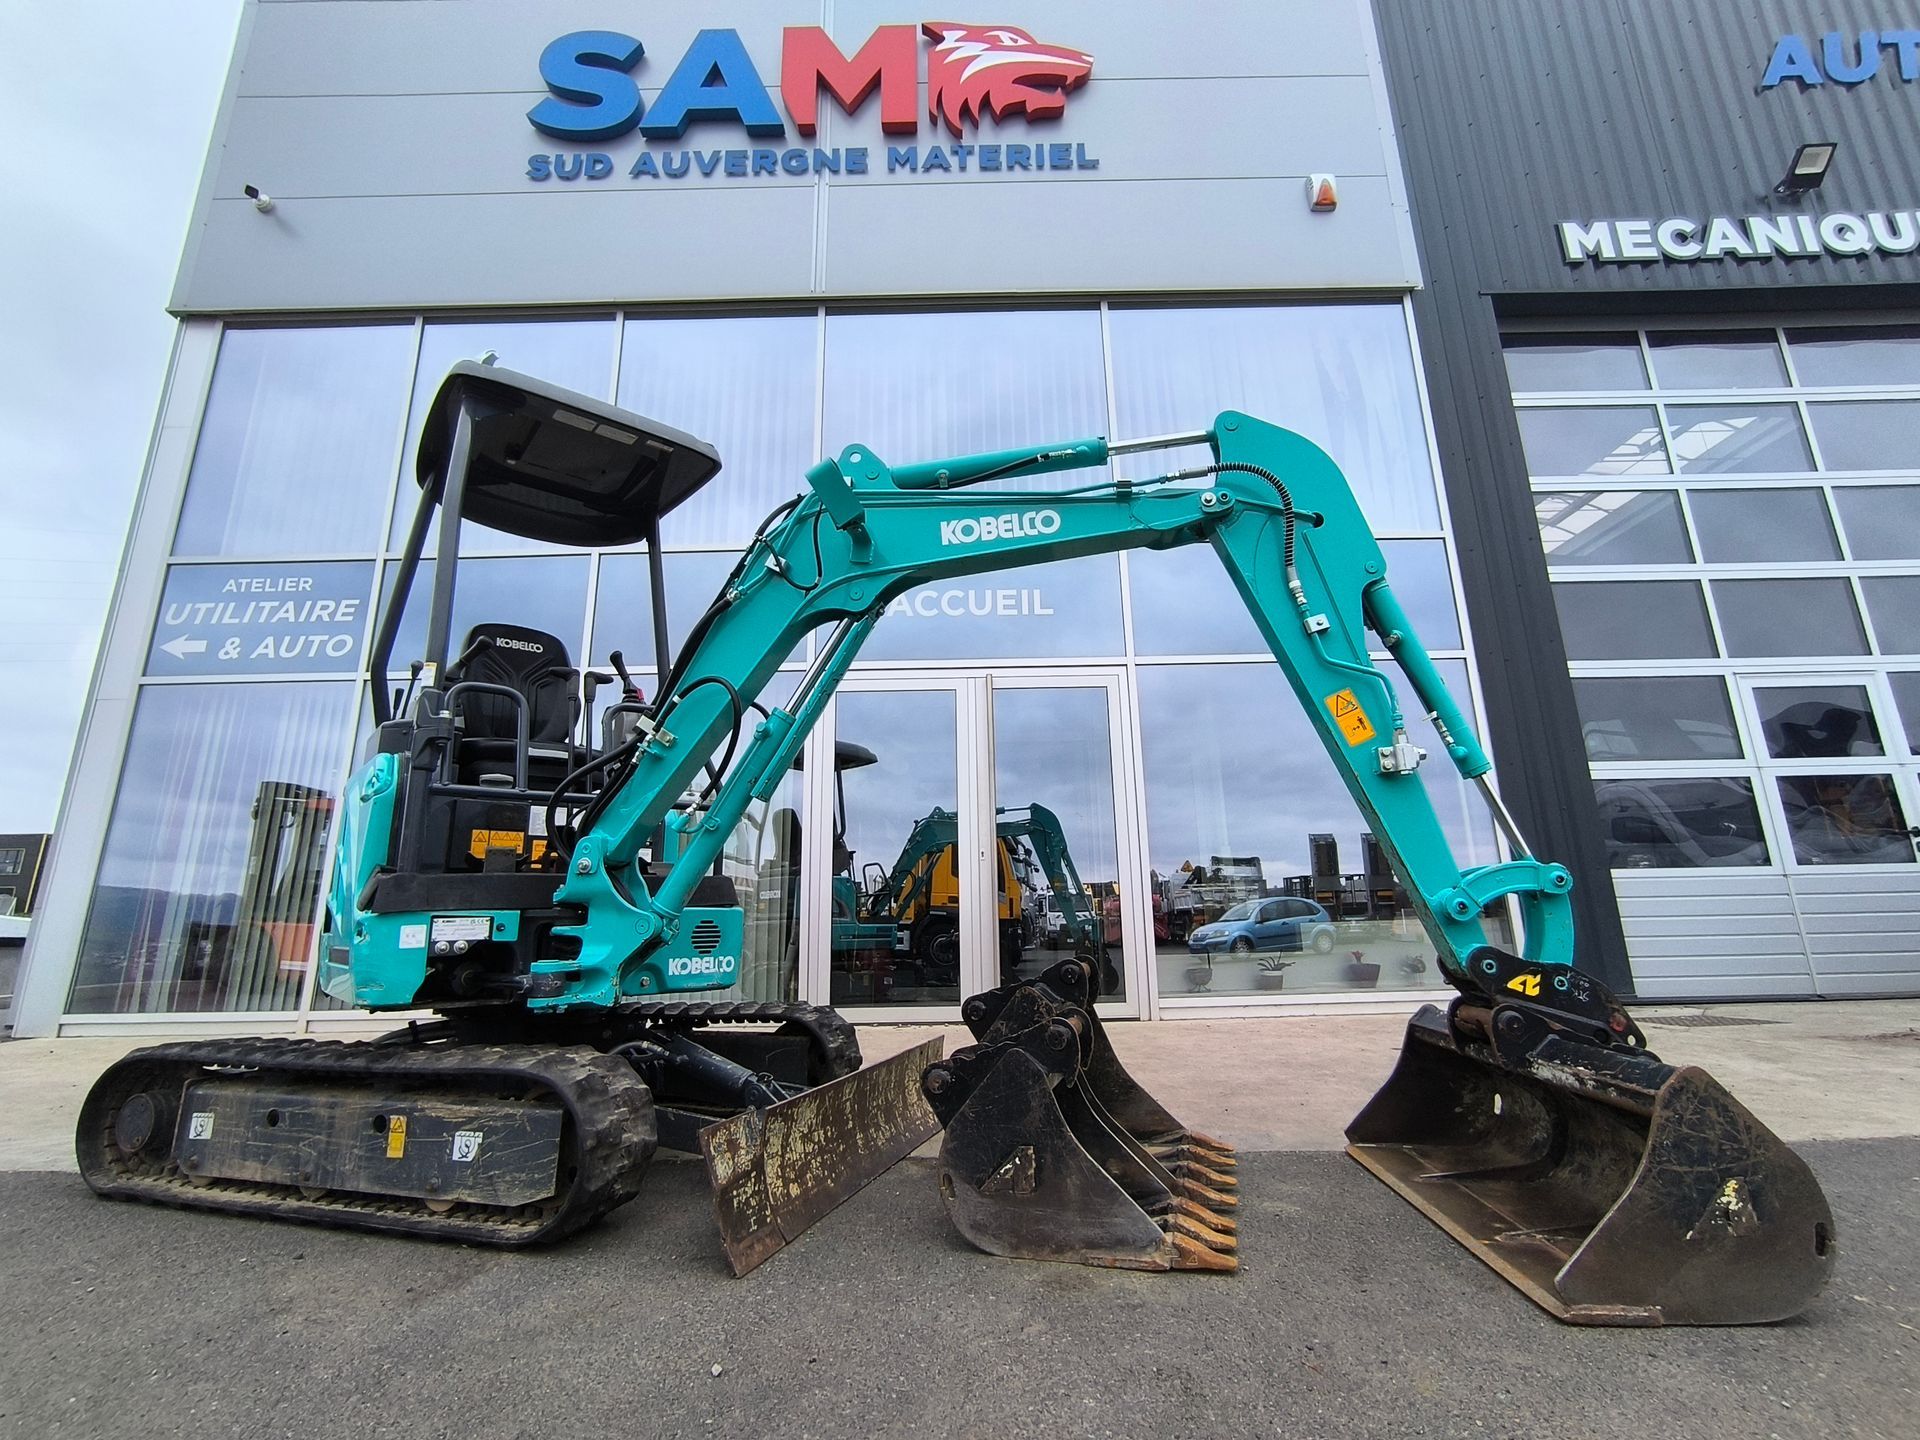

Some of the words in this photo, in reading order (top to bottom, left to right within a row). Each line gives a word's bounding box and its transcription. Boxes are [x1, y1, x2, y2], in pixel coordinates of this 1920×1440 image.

[526, 25, 918, 139] SAM
[525, 153, 613, 180] SUD
[629, 148, 868, 178] AUVERGNE
[887, 143, 1099, 172] MATERIEL
[1559, 210, 1920, 262] MECANIQU
[940, 509, 1061, 546] KOBELCO
[222, 577, 313, 593] ATELIER
[165, 599, 360, 625] UTILITAIRE
[886, 588, 1054, 617] ACCUEIL
[217, 637, 242, 660] &
[250, 634, 354, 659] AUTO
[496, 637, 543, 653] KOBELCO
